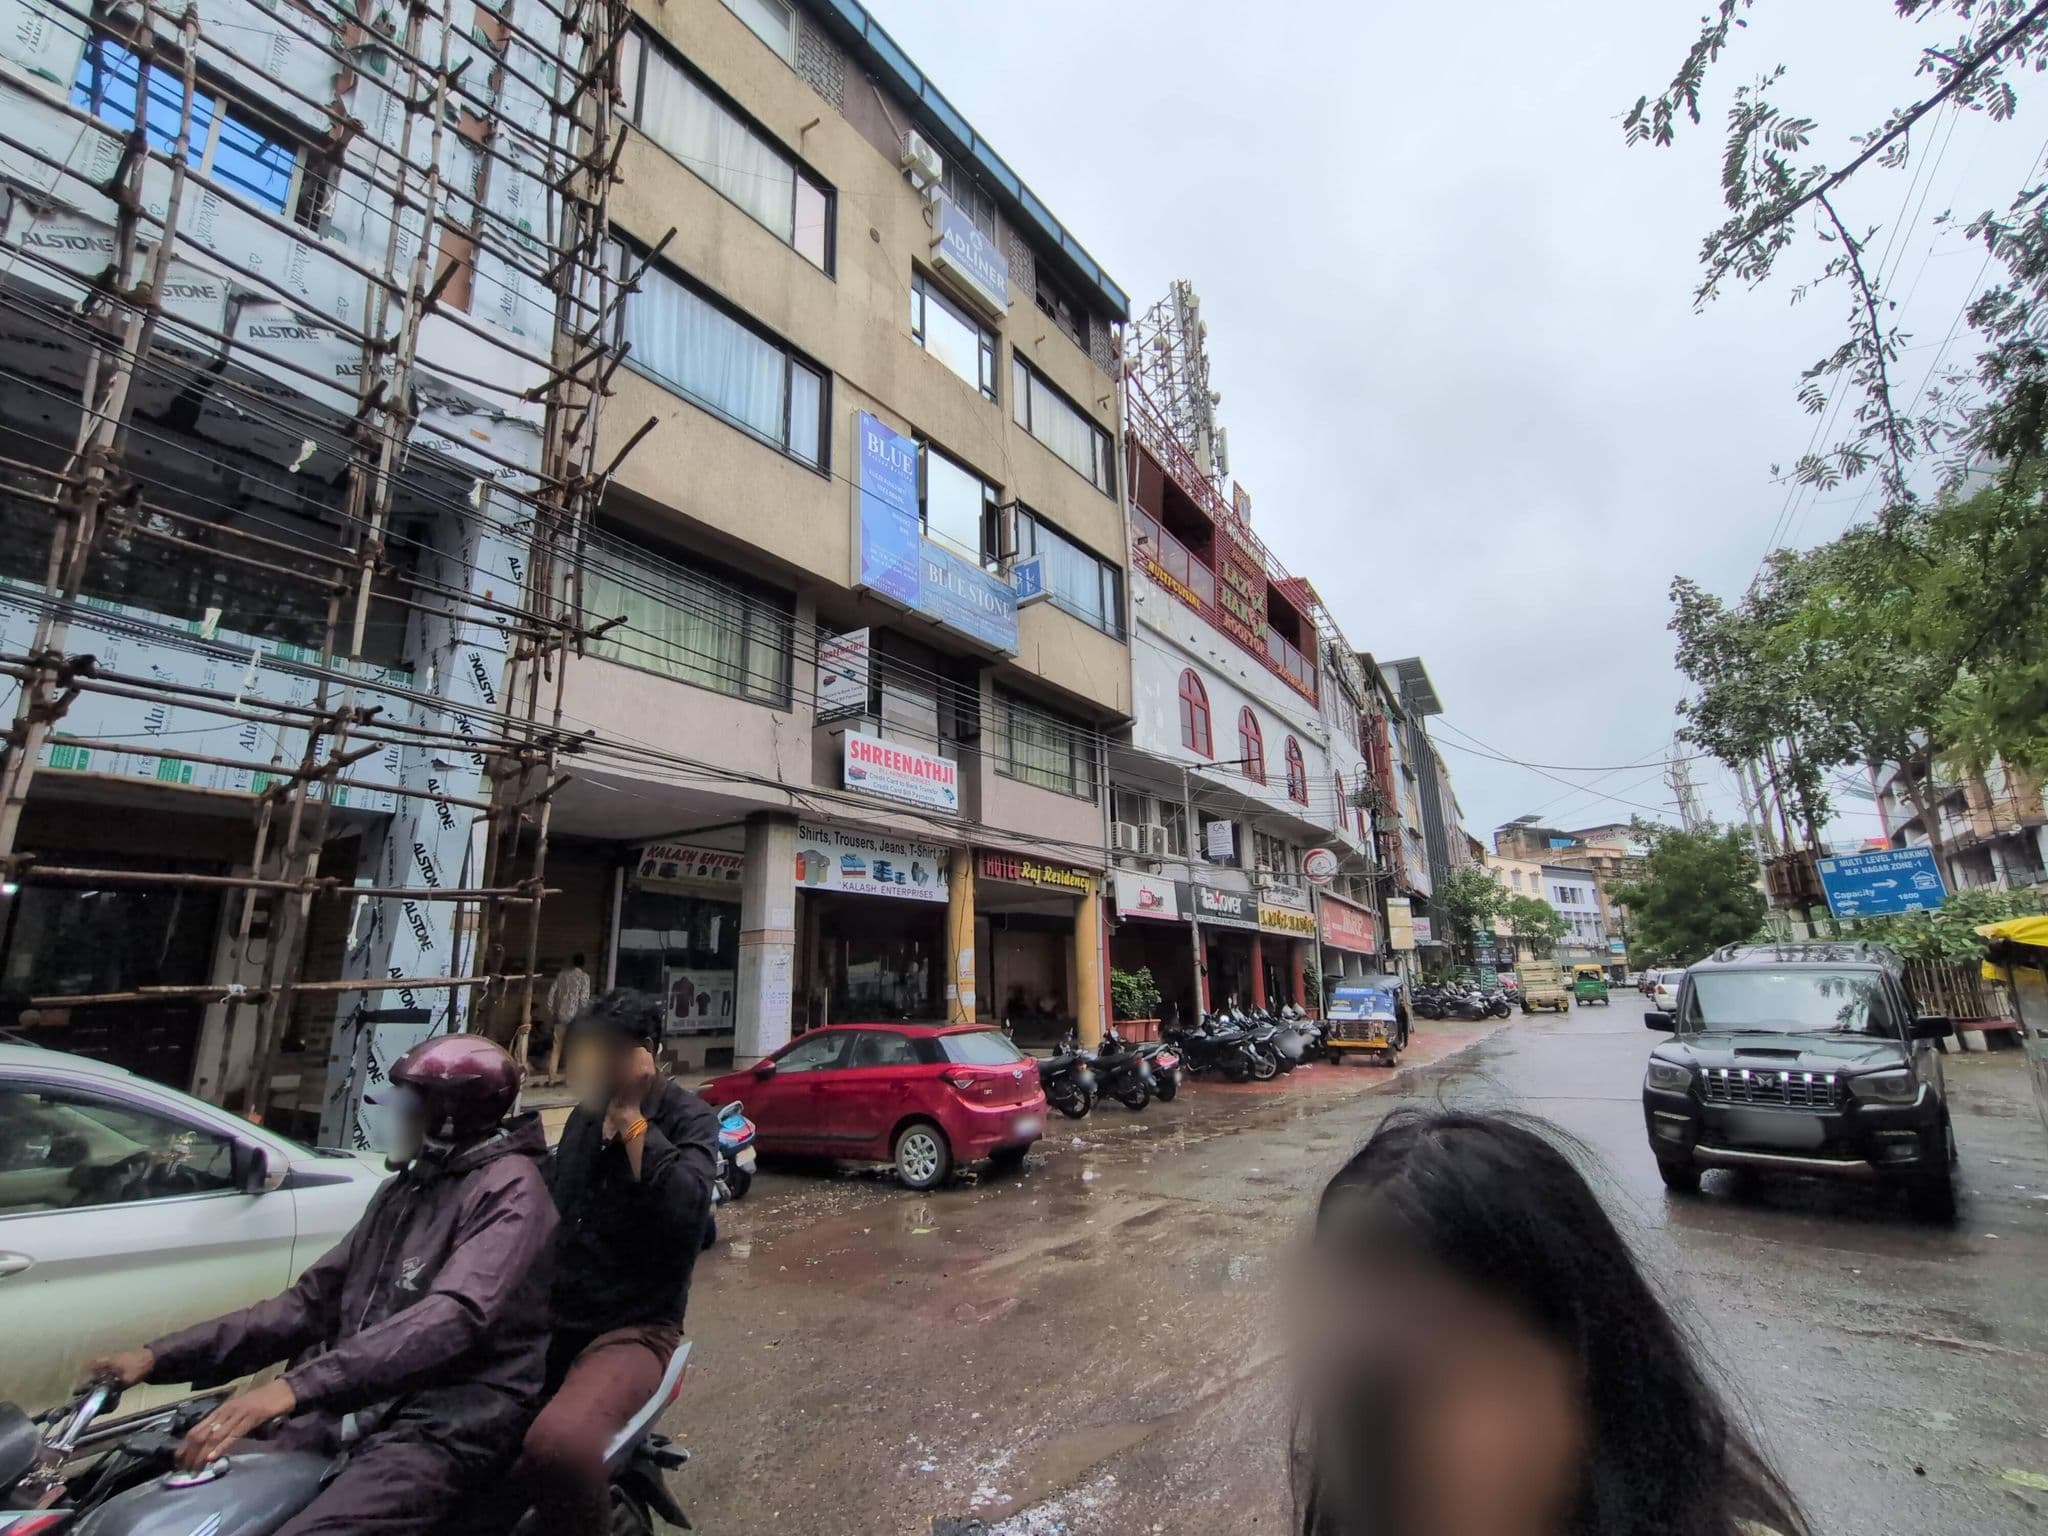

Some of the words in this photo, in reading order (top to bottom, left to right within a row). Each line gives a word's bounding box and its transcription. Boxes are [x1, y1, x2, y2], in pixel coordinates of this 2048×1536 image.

[20, 231, 114, 251] ALSTONE
[944, 227, 1005, 292] ADLINER
[163, 284, 218, 300] STONE
[249, 325, 320, 340] ALSTONE
[868, 432, 912, 475] BLUE
[929, 563, 966, 598] BLUE
[969, 584, 1011, 620] STONE
[468, 652, 497, 705] ALSTONE
[850, 739, 954, 784] SHREENATHJI
[646, 845, 698, 862] KALASH
[799, 825, 831, 846] Shirts,
[834, 831, 877, 852] Trousers,
[879, 839, 907, 857] Jeans,
[413, 842, 440, 888] ALSTON
[1840, 858, 1862, 867] MULTI
[1865, 855, 1891, 864] LEVEL
[1893, 849, 1930, 860] PARKING
[1861, 864, 1890, 874] NAGAR
[1891, 861, 1914, 871] ZONE
[842, 881, 877, 894] KALASH
[880, 885, 934, 899] ENTERPRISES
[1021, 861, 1041, 884] Raj
[1043, 865, 1090, 893] Residency
[1833, 888, 1876, 900] Capacity
[402, 900, 434, 953] ALSTONE
